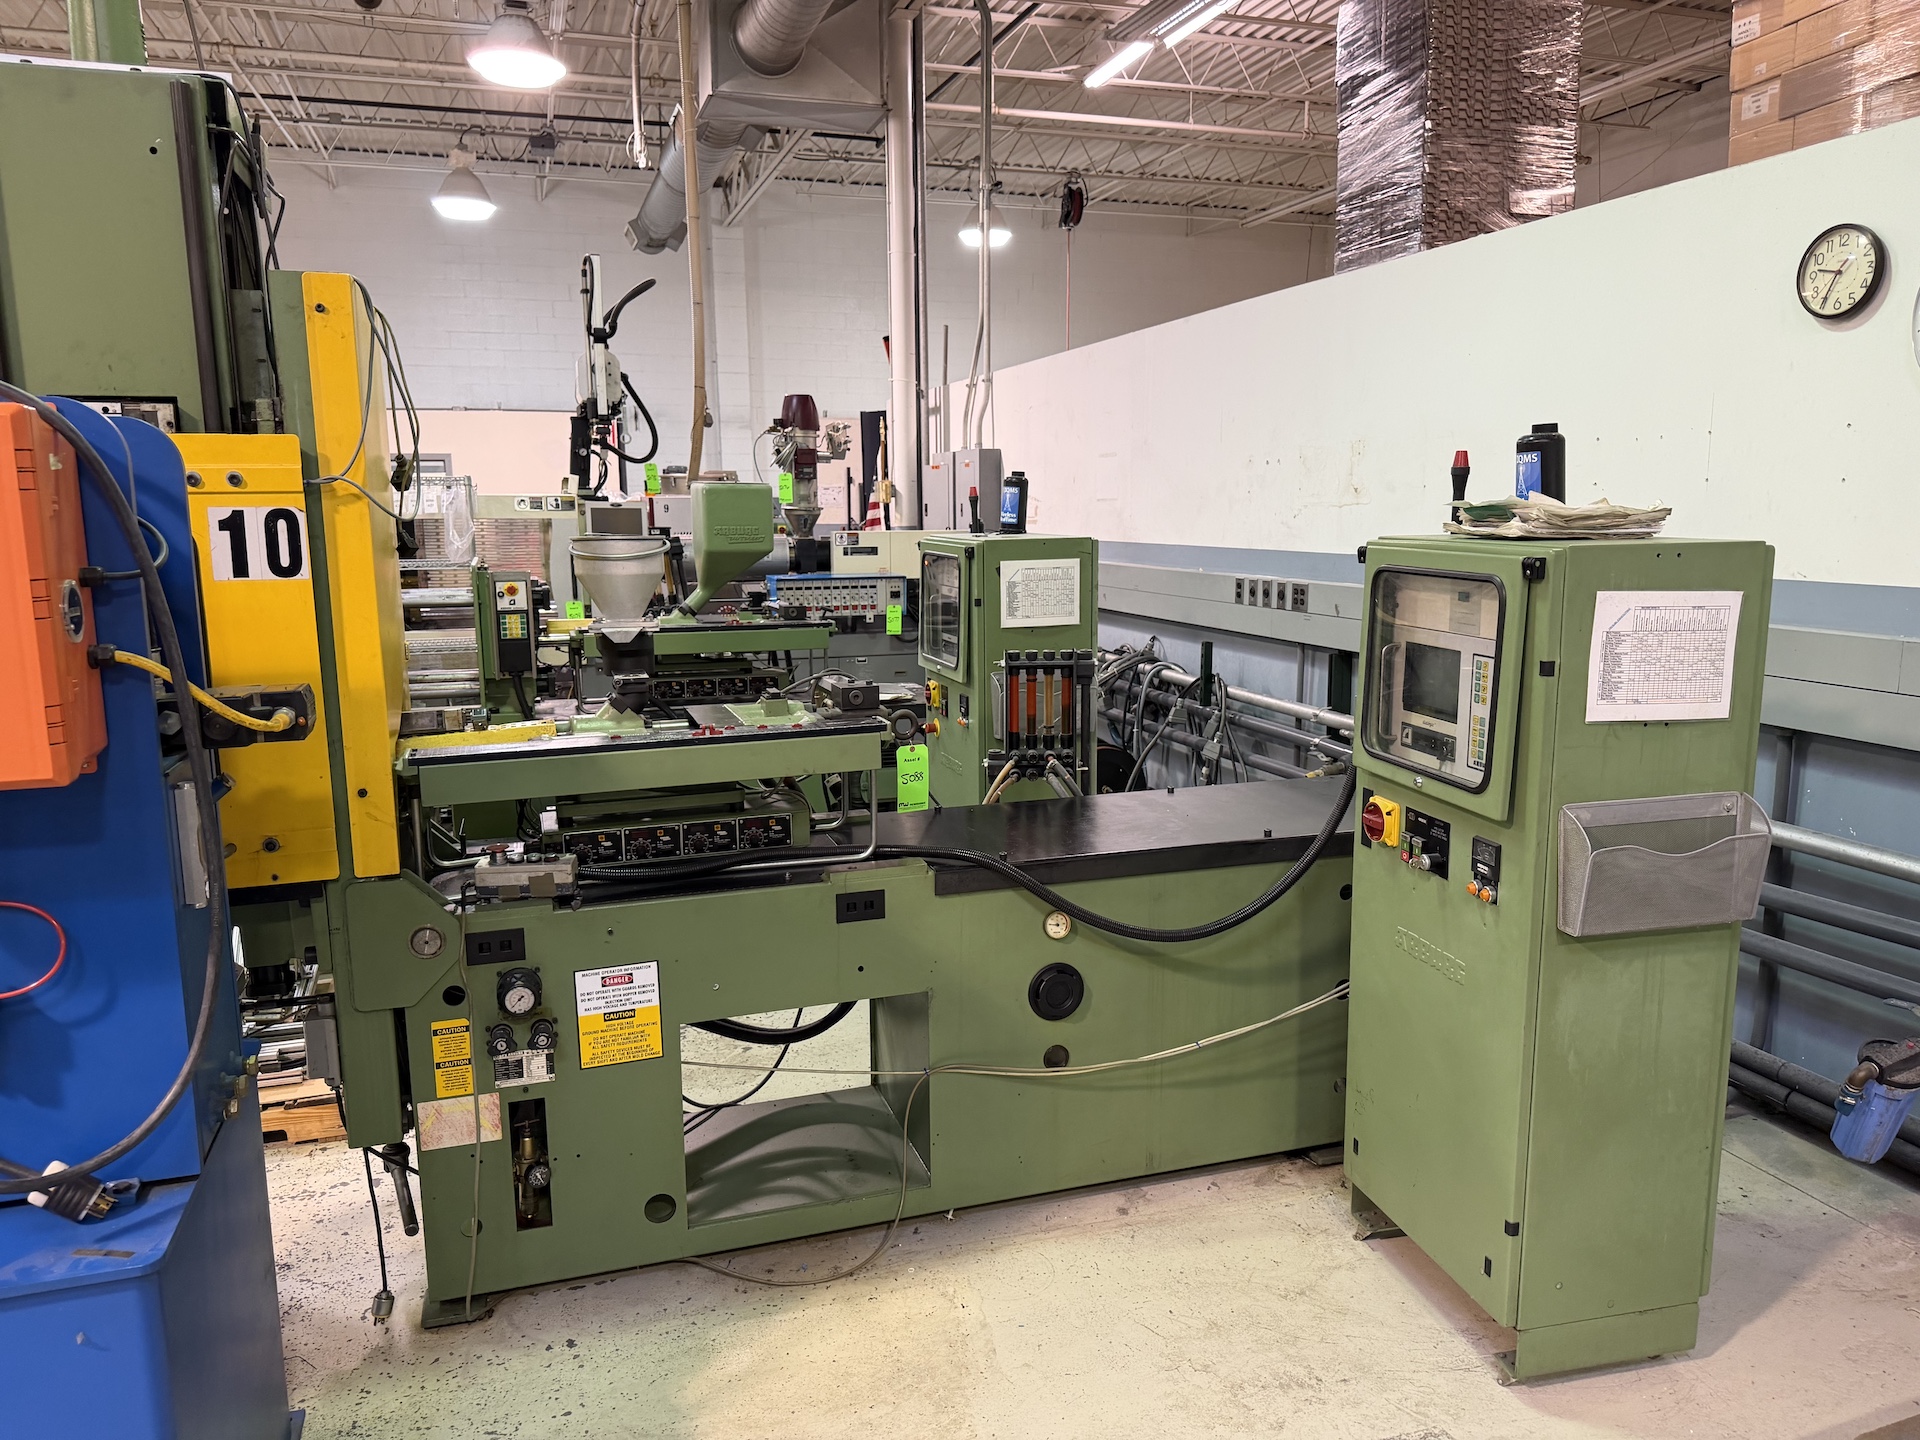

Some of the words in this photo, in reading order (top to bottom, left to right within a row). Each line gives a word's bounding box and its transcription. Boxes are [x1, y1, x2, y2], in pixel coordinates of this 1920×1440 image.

[1826, 240, 1834, 253] 11
[1838, 233, 1850, 247] 12
[1856, 235, 1860, 248] 1
[1864, 242, 1874, 256] 2
[1813, 252, 1824, 266] 10
[1866, 260, 1874, 274] 3
[1809, 270, 1818, 284] 9
[1860, 278, 1870, 288] 4
[1811, 286, 1819, 299] 8
[1848, 292, 1856, 305] 5
[1833, 297, 1842, 310] 6
[664, 504, 669, 513] 9
[218, 508, 302, 578] 10
[901, 771, 924, 785] 5088
[606, 976, 628, 984] DANGER
[605, 1010, 634, 1020] CAUTION
[437, 1026, 466, 1035] CAUTION
[440, 1059, 469, 1068] CAUTION
